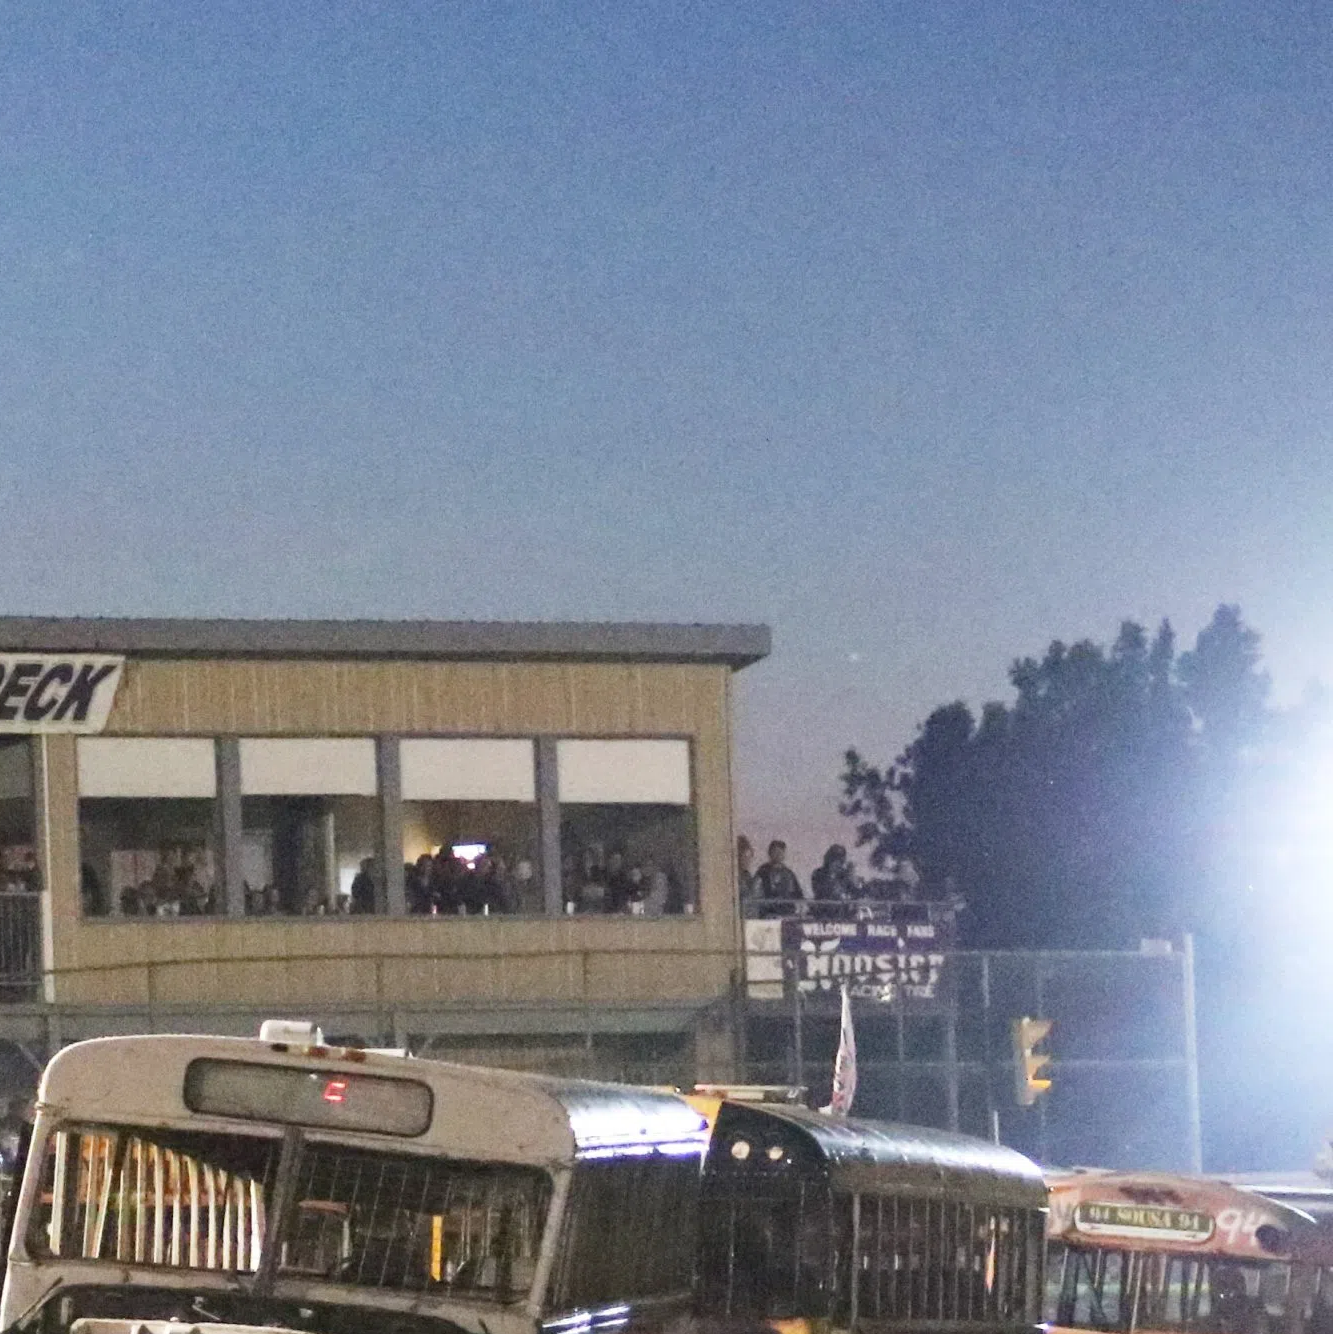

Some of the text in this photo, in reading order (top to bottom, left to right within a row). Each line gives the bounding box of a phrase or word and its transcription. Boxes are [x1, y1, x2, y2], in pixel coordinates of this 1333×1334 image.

[802, 922, 858, 937] WELCOME
[844, 984, 897, 998] ACING
[1116, 1208, 1172, 1228] SOUSA
